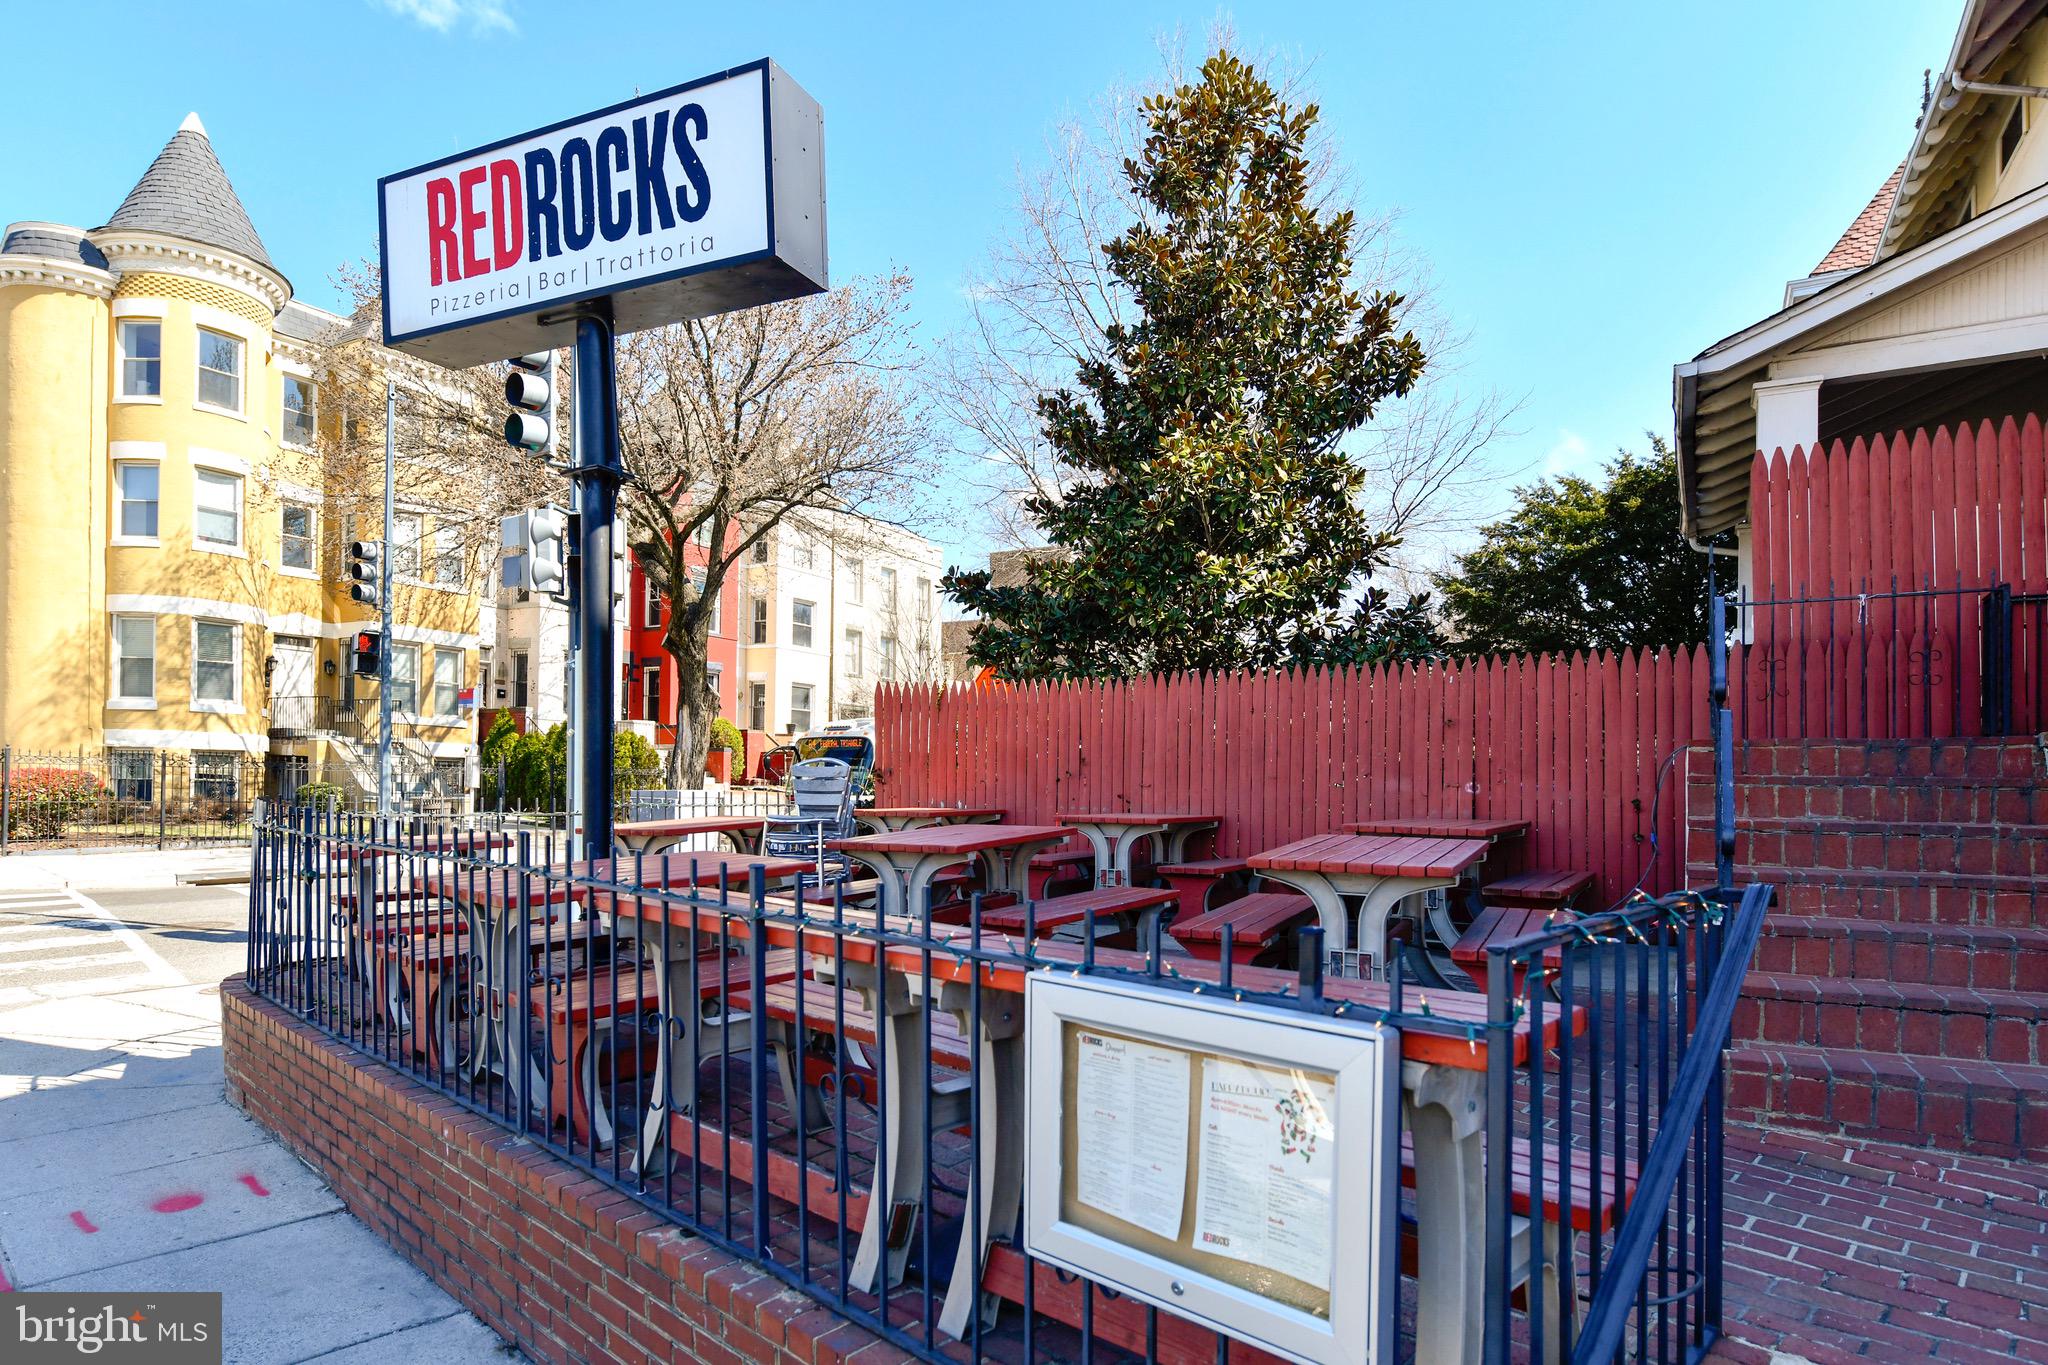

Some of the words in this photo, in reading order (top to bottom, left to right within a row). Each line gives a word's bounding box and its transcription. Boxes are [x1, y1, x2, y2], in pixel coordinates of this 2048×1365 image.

[426, 102, 712, 287] REDROCKS
[430, 281, 520, 316] Pizzeria
[539, 268, 576, 291] Bar
[596, 233, 715, 277] Trattoria
